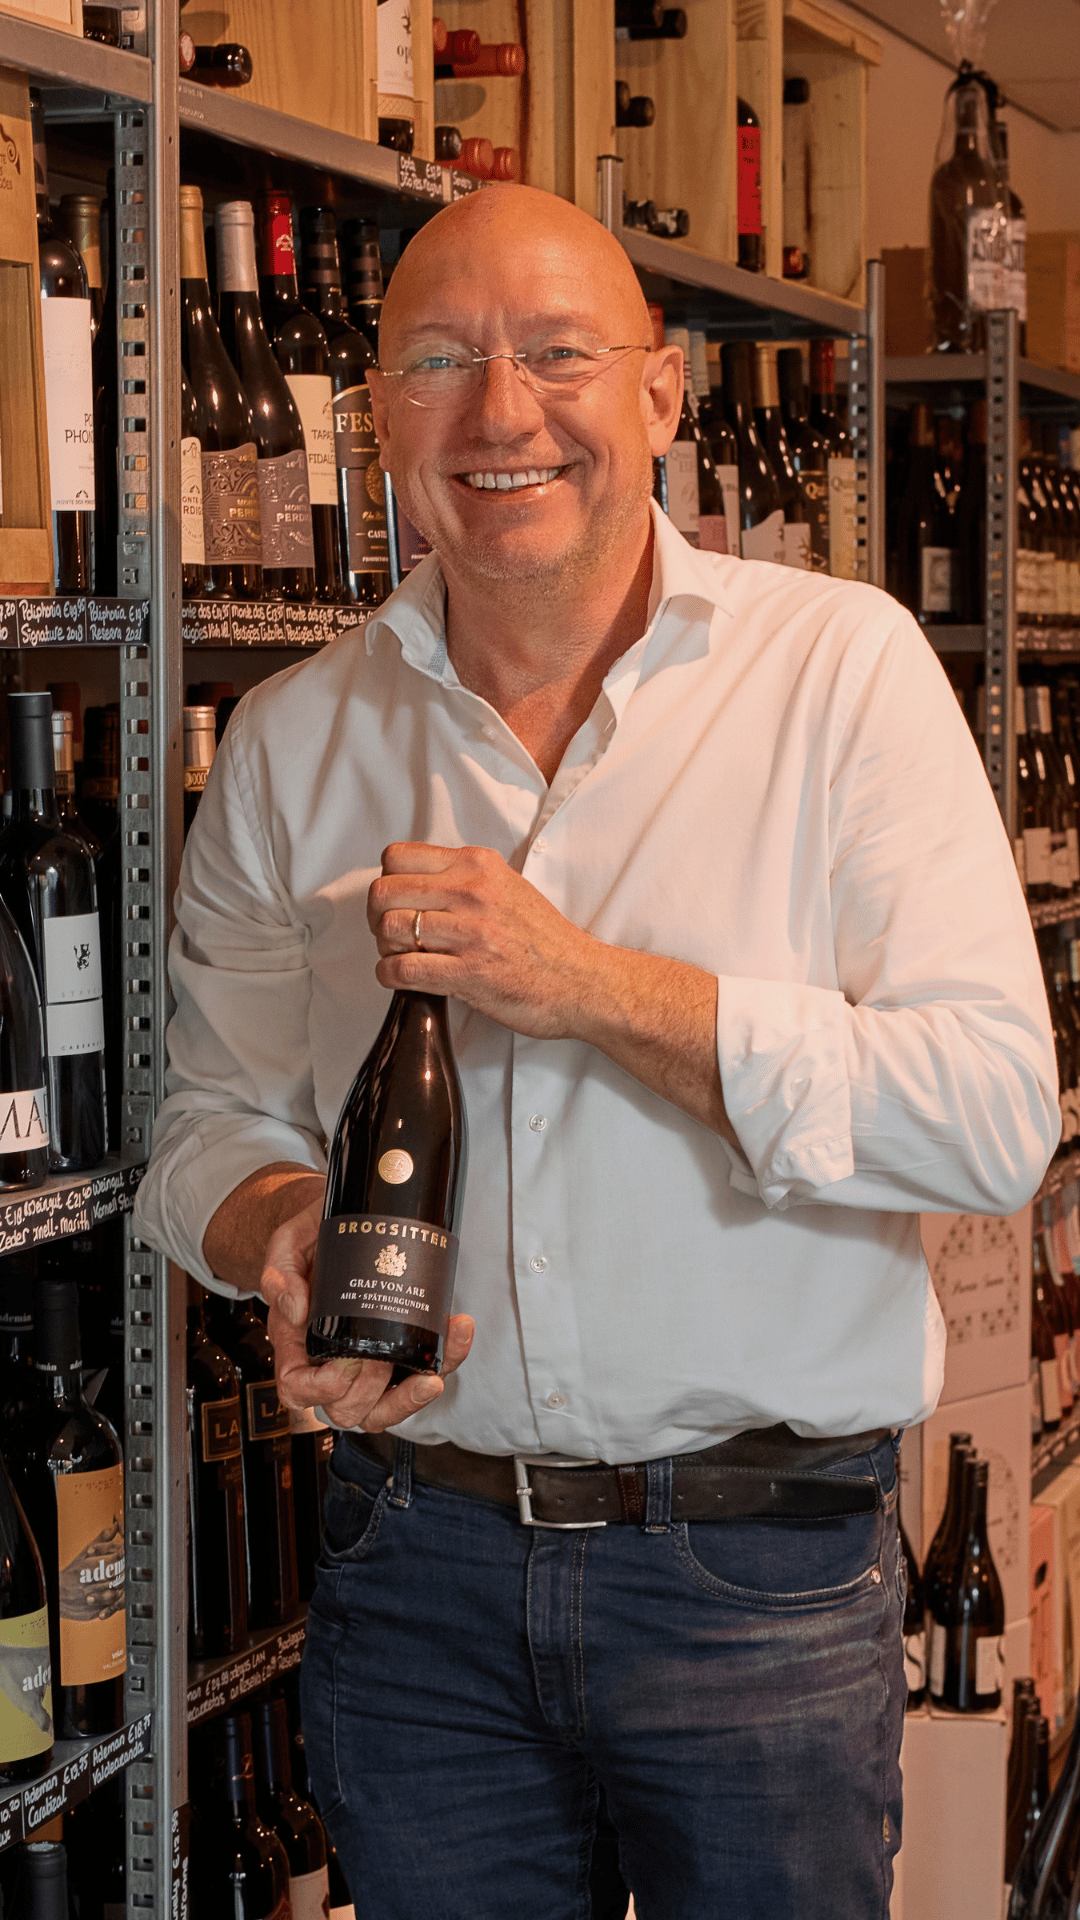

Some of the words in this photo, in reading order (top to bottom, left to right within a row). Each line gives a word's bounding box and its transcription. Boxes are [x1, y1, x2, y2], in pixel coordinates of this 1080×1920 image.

[335, 412, 374, 434] FES
[181, 603, 197, 619] onte
[21, 622, 64, 646] Signature
[61, 1040, 103, 1051] CABERNE
[338, 1220, 448, 1250] BROGSITTER
[349, 1278, 379, 1290] GRAF
[380, 1280, 405, 1293] VON
[405, 1285, 427, 1299] ARE
[362, 1292, 431, 1312] SPÄTBURGUNDER
[379, 1304, 410, 1315] TROCKEN
[80, 1559, 126, 1584] adem
[24, 1774, 59, 1807] Ademan
